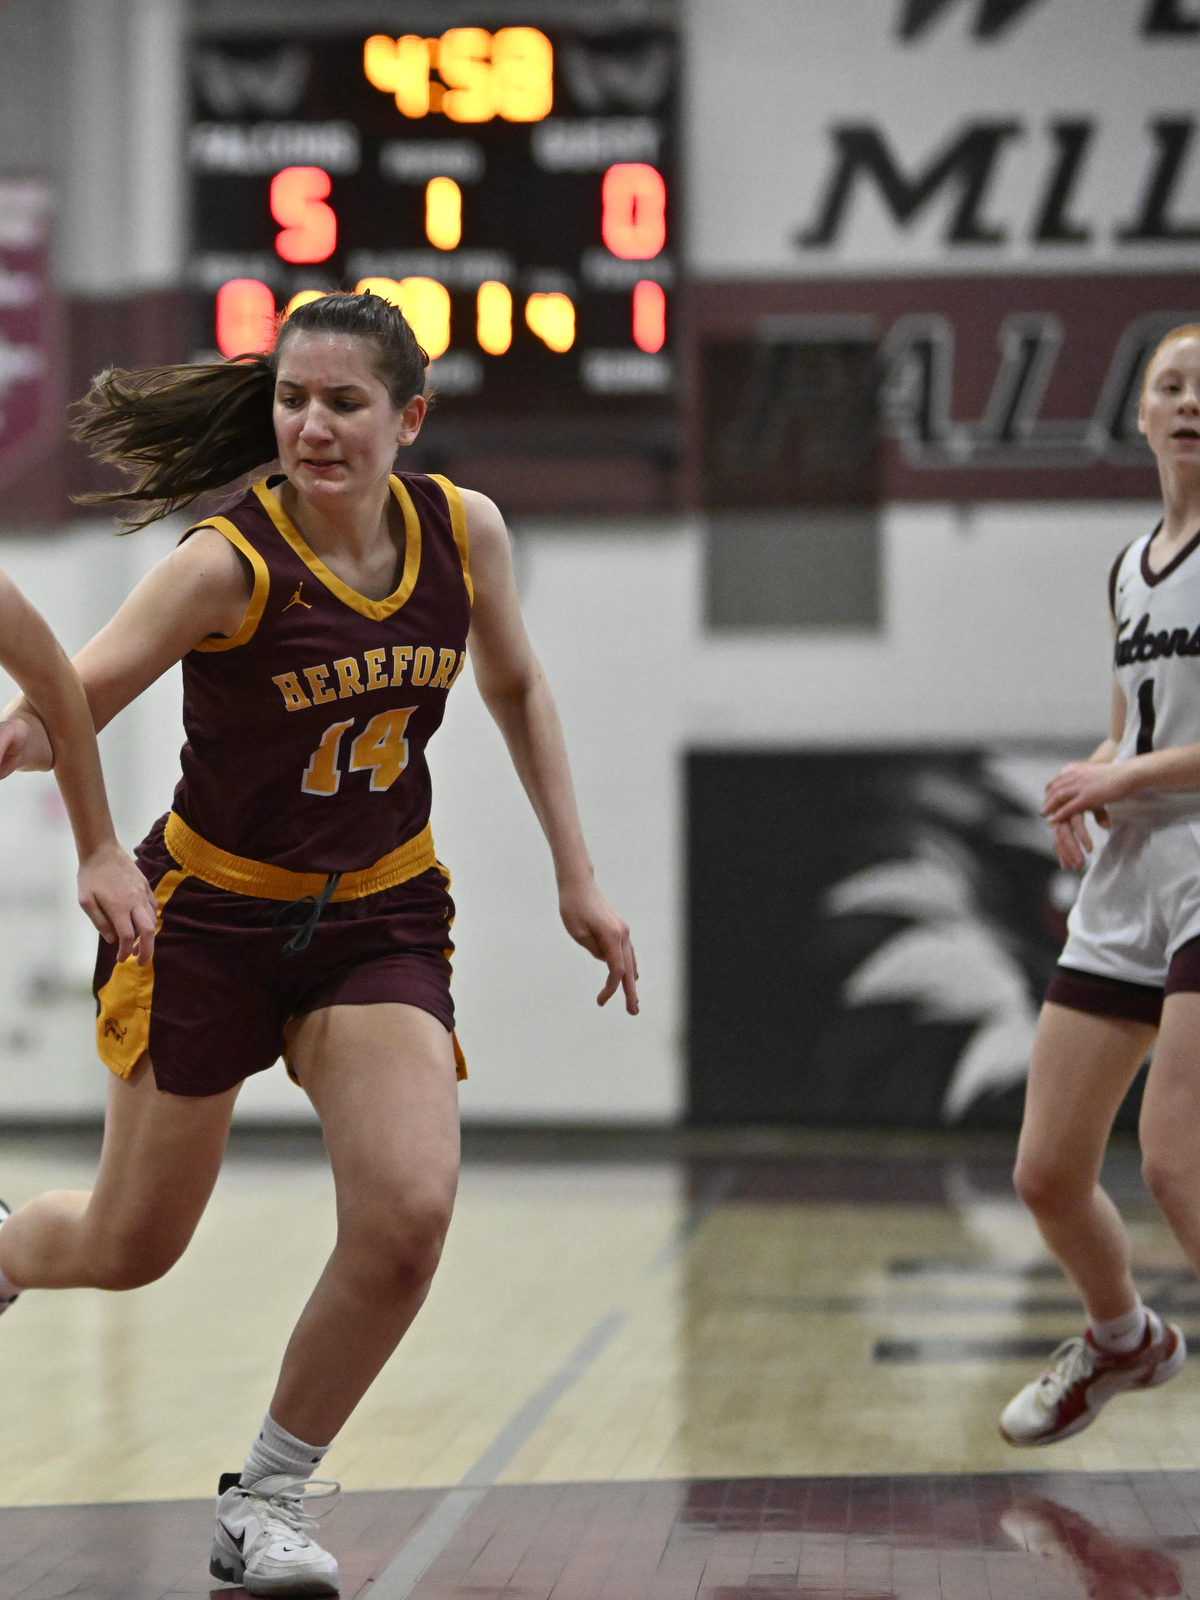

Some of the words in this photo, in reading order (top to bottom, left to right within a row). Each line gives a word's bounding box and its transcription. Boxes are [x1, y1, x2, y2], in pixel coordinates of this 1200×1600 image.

[270, 167, 336, 262] 5
[426, 177, 461, 249] 1
[602, 163, 666, 259] 0
[301, 705, 420, 797] 14
